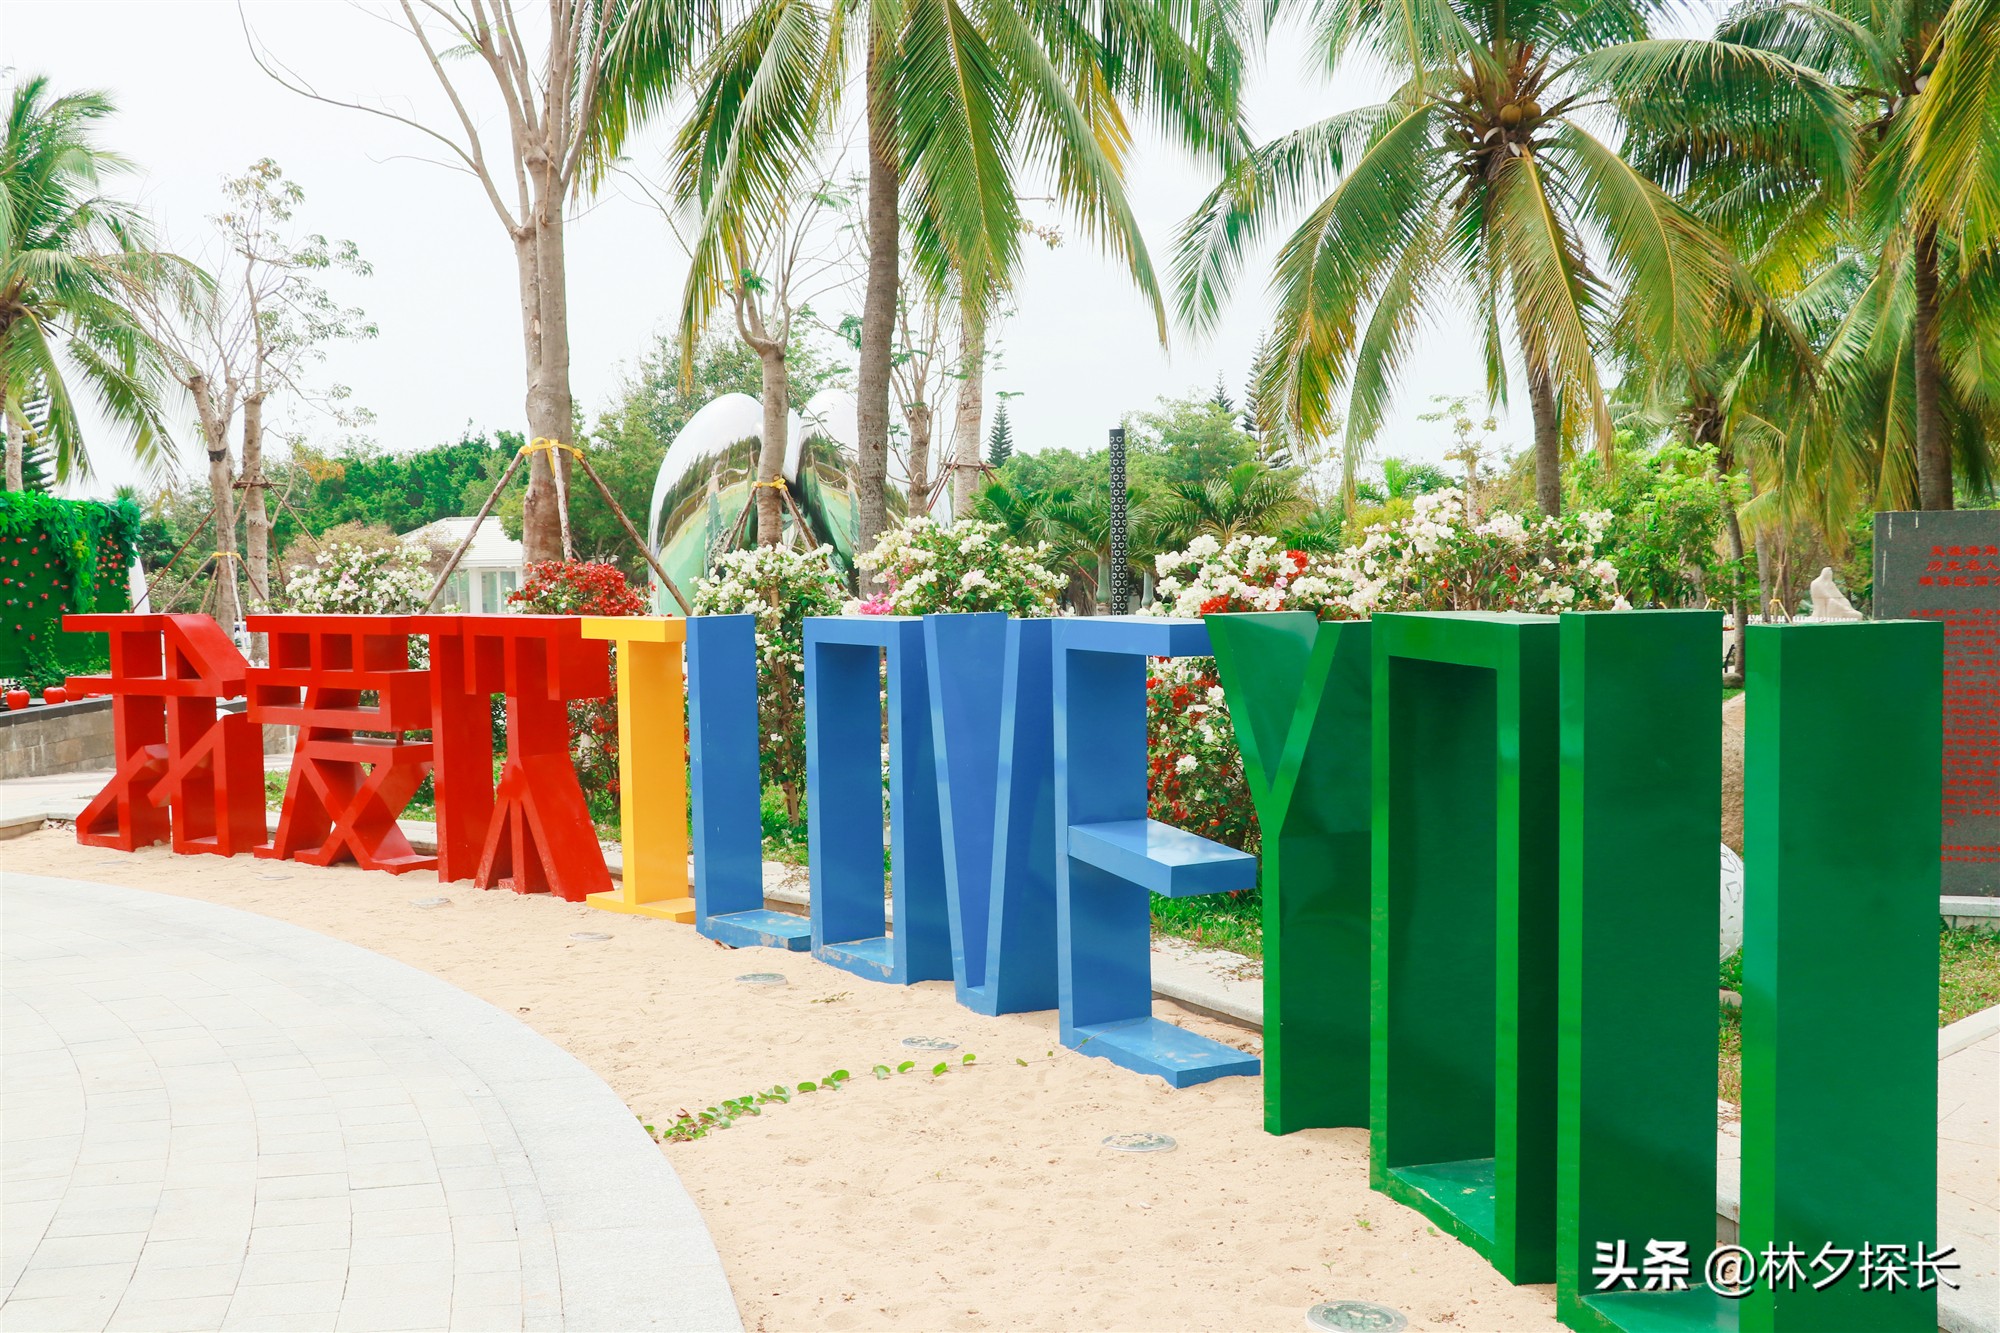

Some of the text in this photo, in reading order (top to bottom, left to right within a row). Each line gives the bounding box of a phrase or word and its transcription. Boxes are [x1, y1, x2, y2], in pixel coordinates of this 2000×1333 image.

[581, 615, 697, 923] I
[687, 611, 1261, 1089] LOVE
[1204, 608, 1944, 1333] YOU
